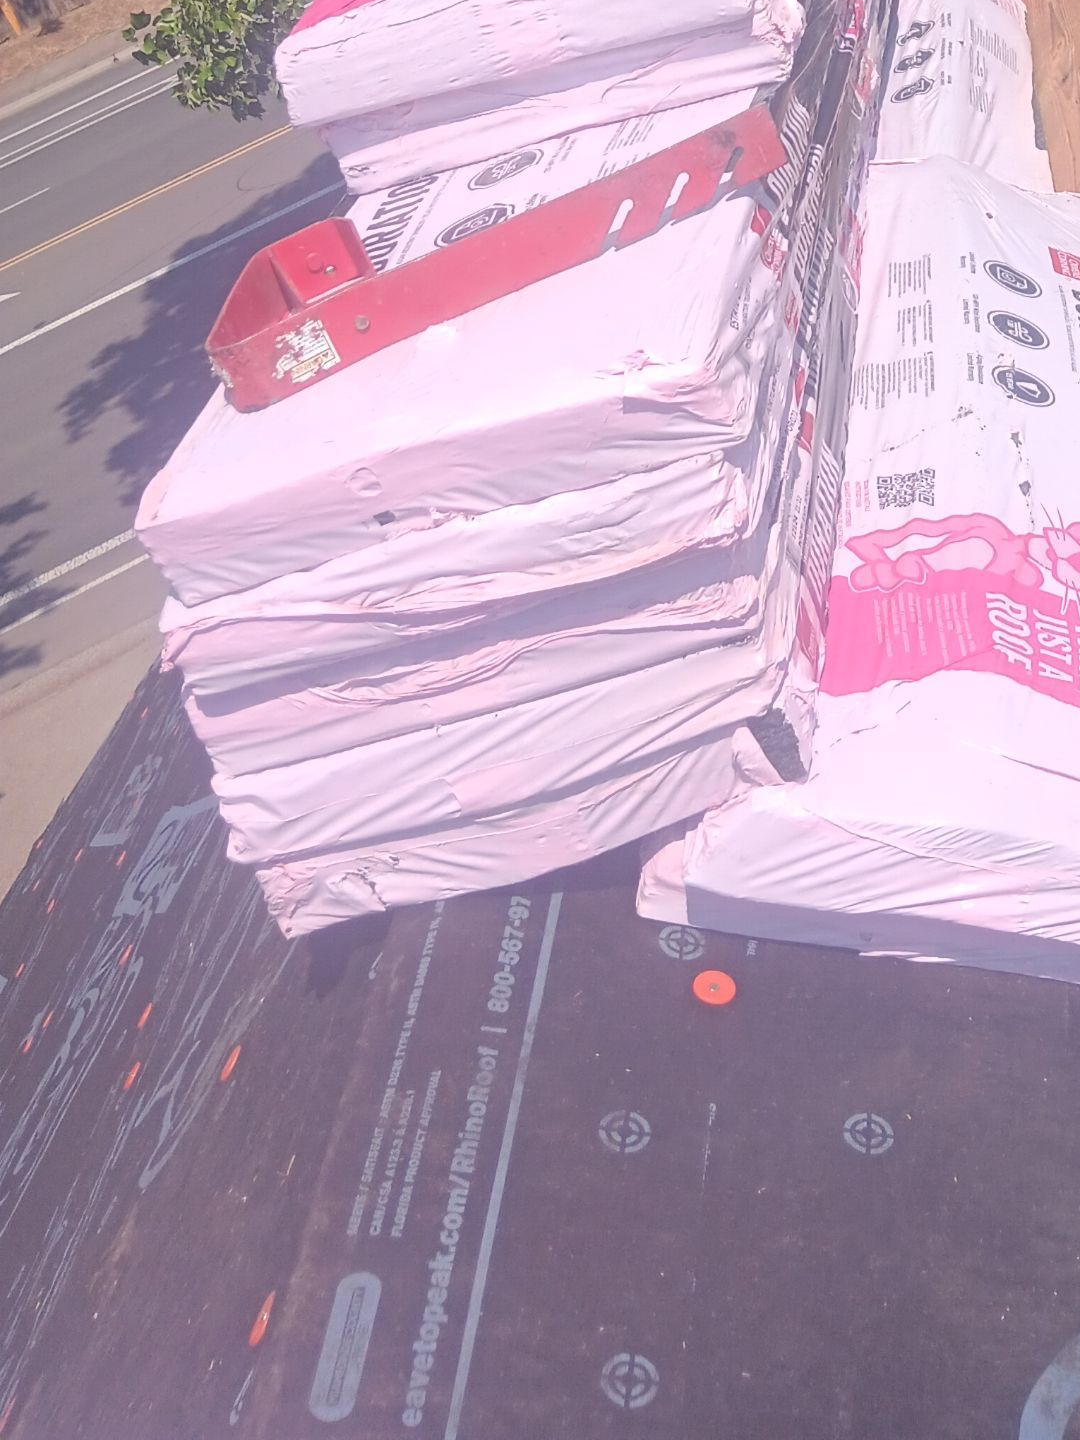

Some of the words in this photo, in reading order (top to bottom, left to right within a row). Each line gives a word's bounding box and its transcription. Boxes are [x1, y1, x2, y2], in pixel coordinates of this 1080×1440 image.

[985, 592, 1033, 671] ROOF
[1031, 608, 1072, 664] JUST
[1038, 662, 1073, 682] A
[377, 1088, 396, 1119] ASTM
[394, 1031, 410, 1056] TYPE
[390, 1186, 414, 1236] FLORIDA
[404, 1129, 427, 1182] PRODUCT
[418, 1069, 442, 1125] APPROVAL
[401, 1045, 500, 1427] eavetopeak.com/RhinoRoof
[486, 896, 532, 1012] 800-567-97
